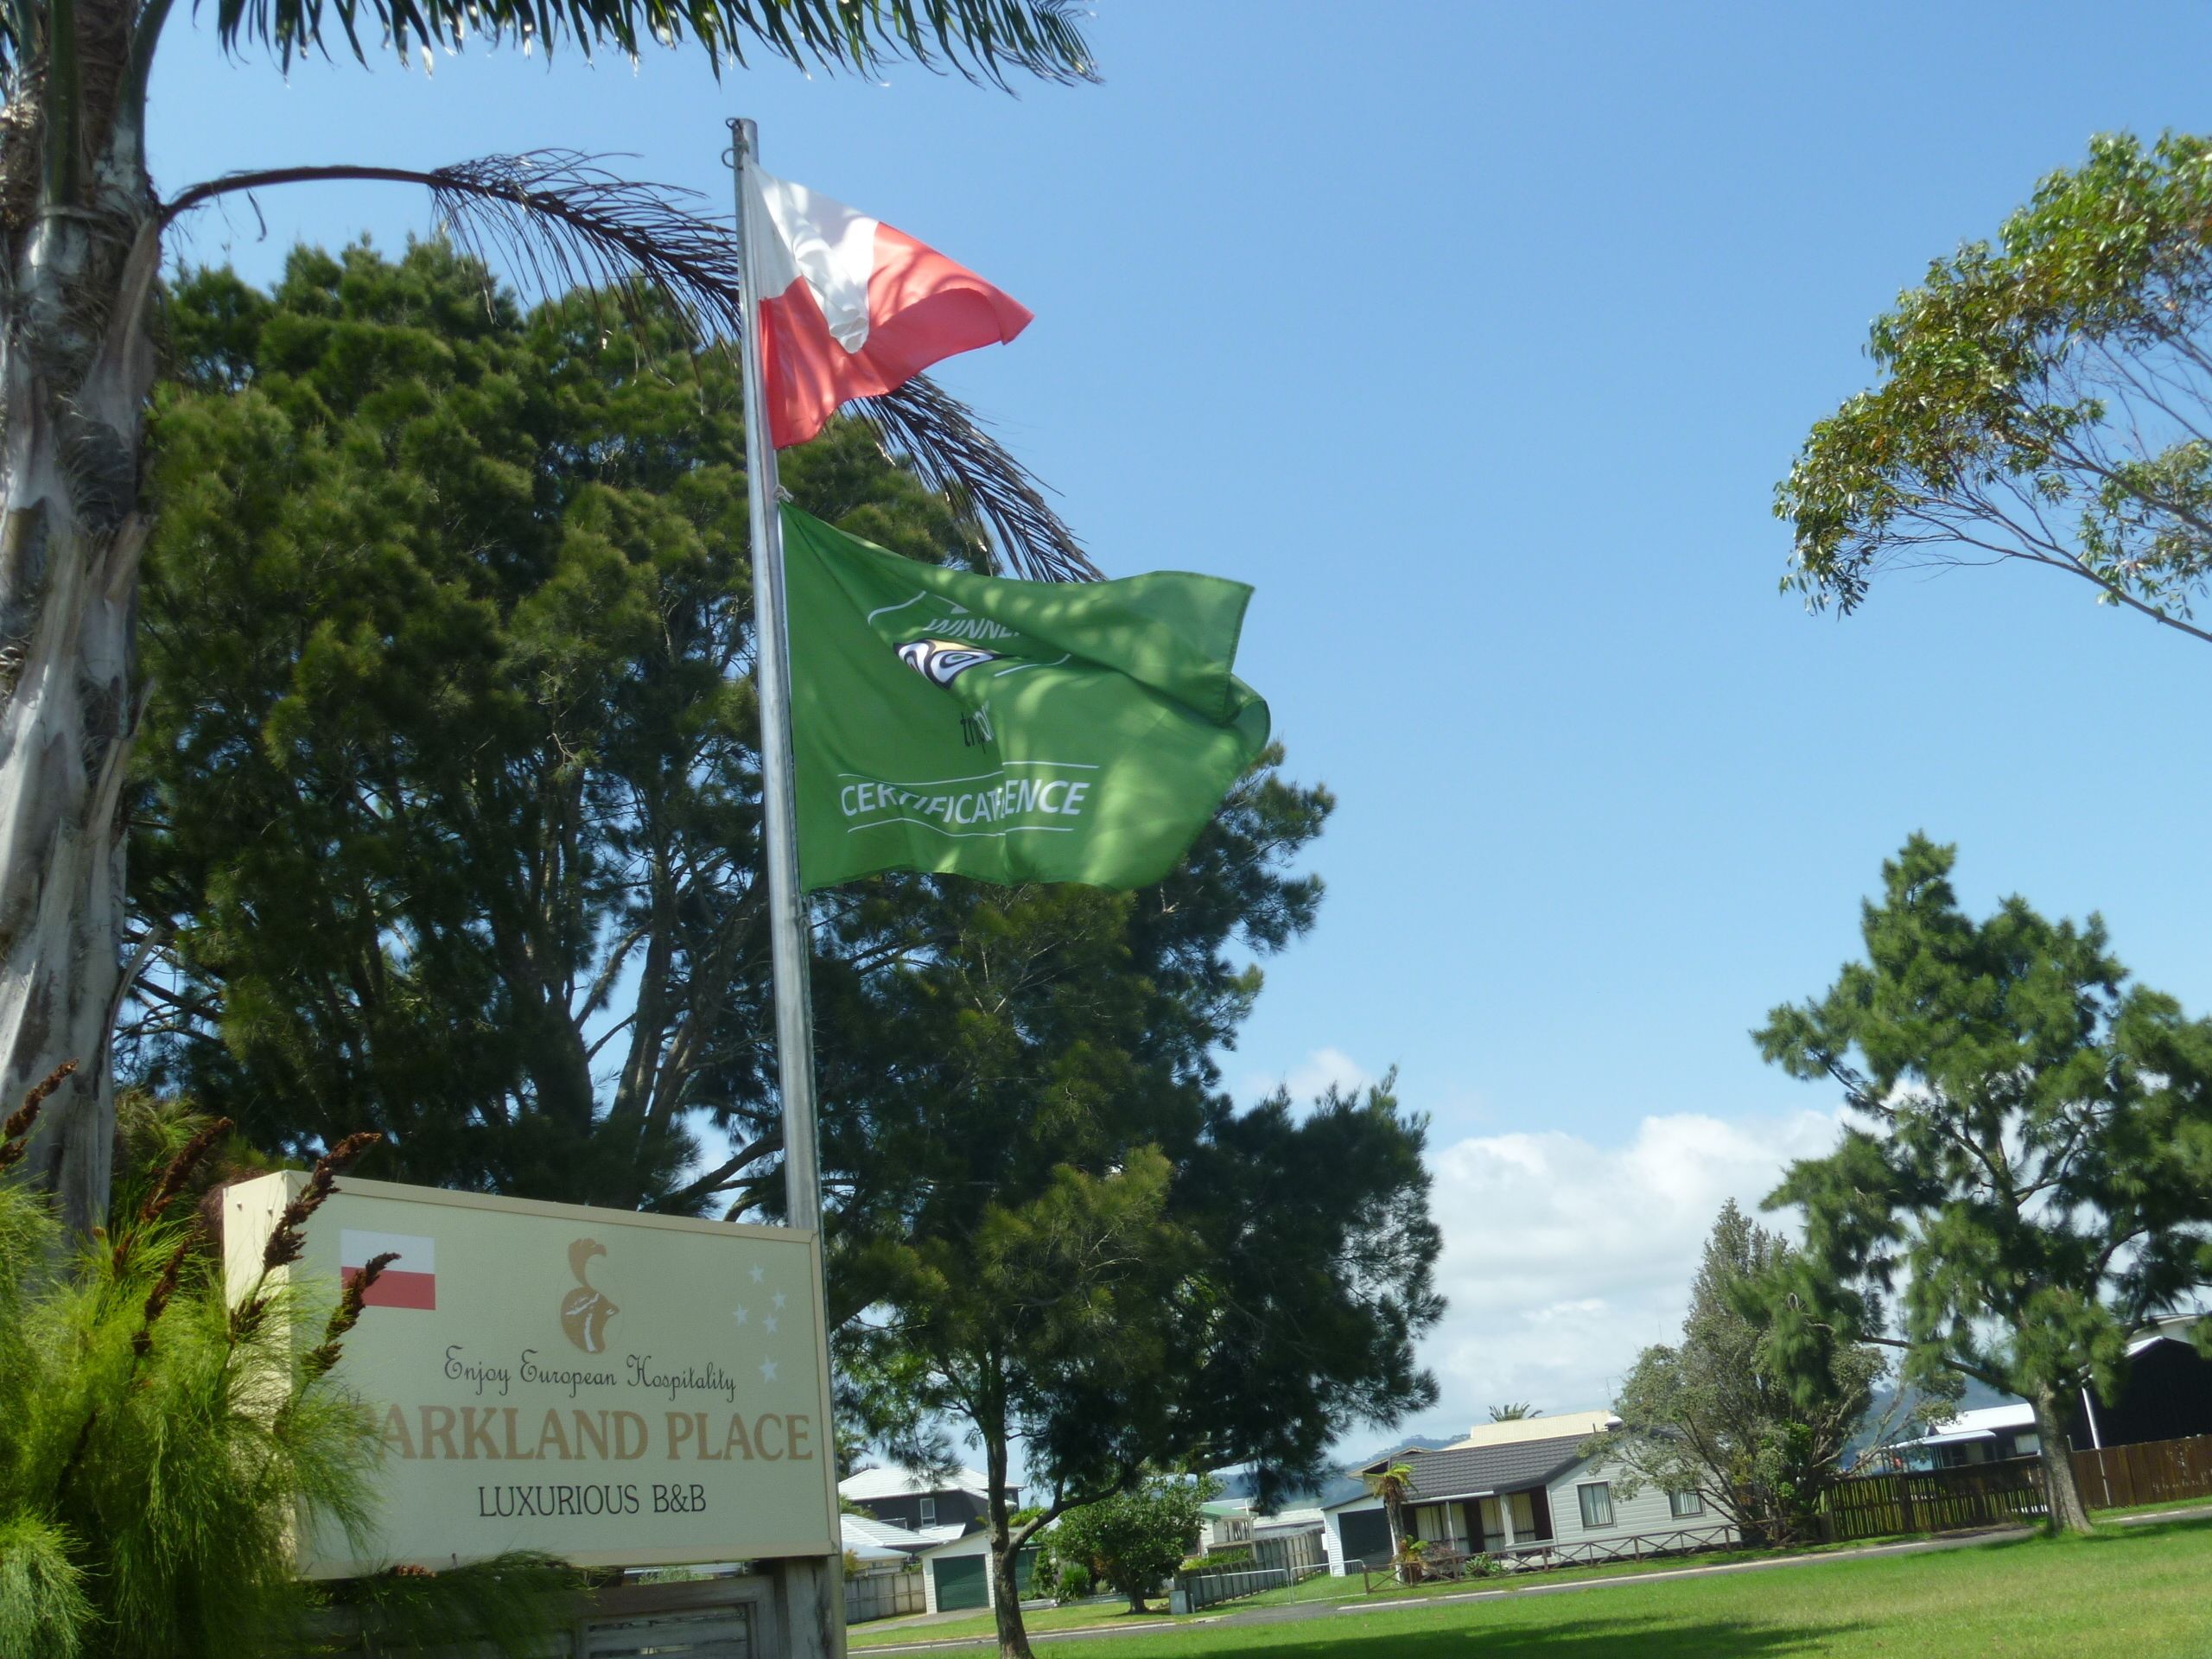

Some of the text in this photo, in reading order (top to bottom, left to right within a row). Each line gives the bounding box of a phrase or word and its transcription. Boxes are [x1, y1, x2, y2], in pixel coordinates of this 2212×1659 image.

[922, 618, 1020, 639] WINN
[841, 779, 1090, 824] CERTIFICAT ENCE
[444, 1344, 736, 1403] Enjoy European Hospitality
[664, 1411, 813, 1461] PLACE
[478, 1484, 707, 1516] LUXURIOUS B&B
